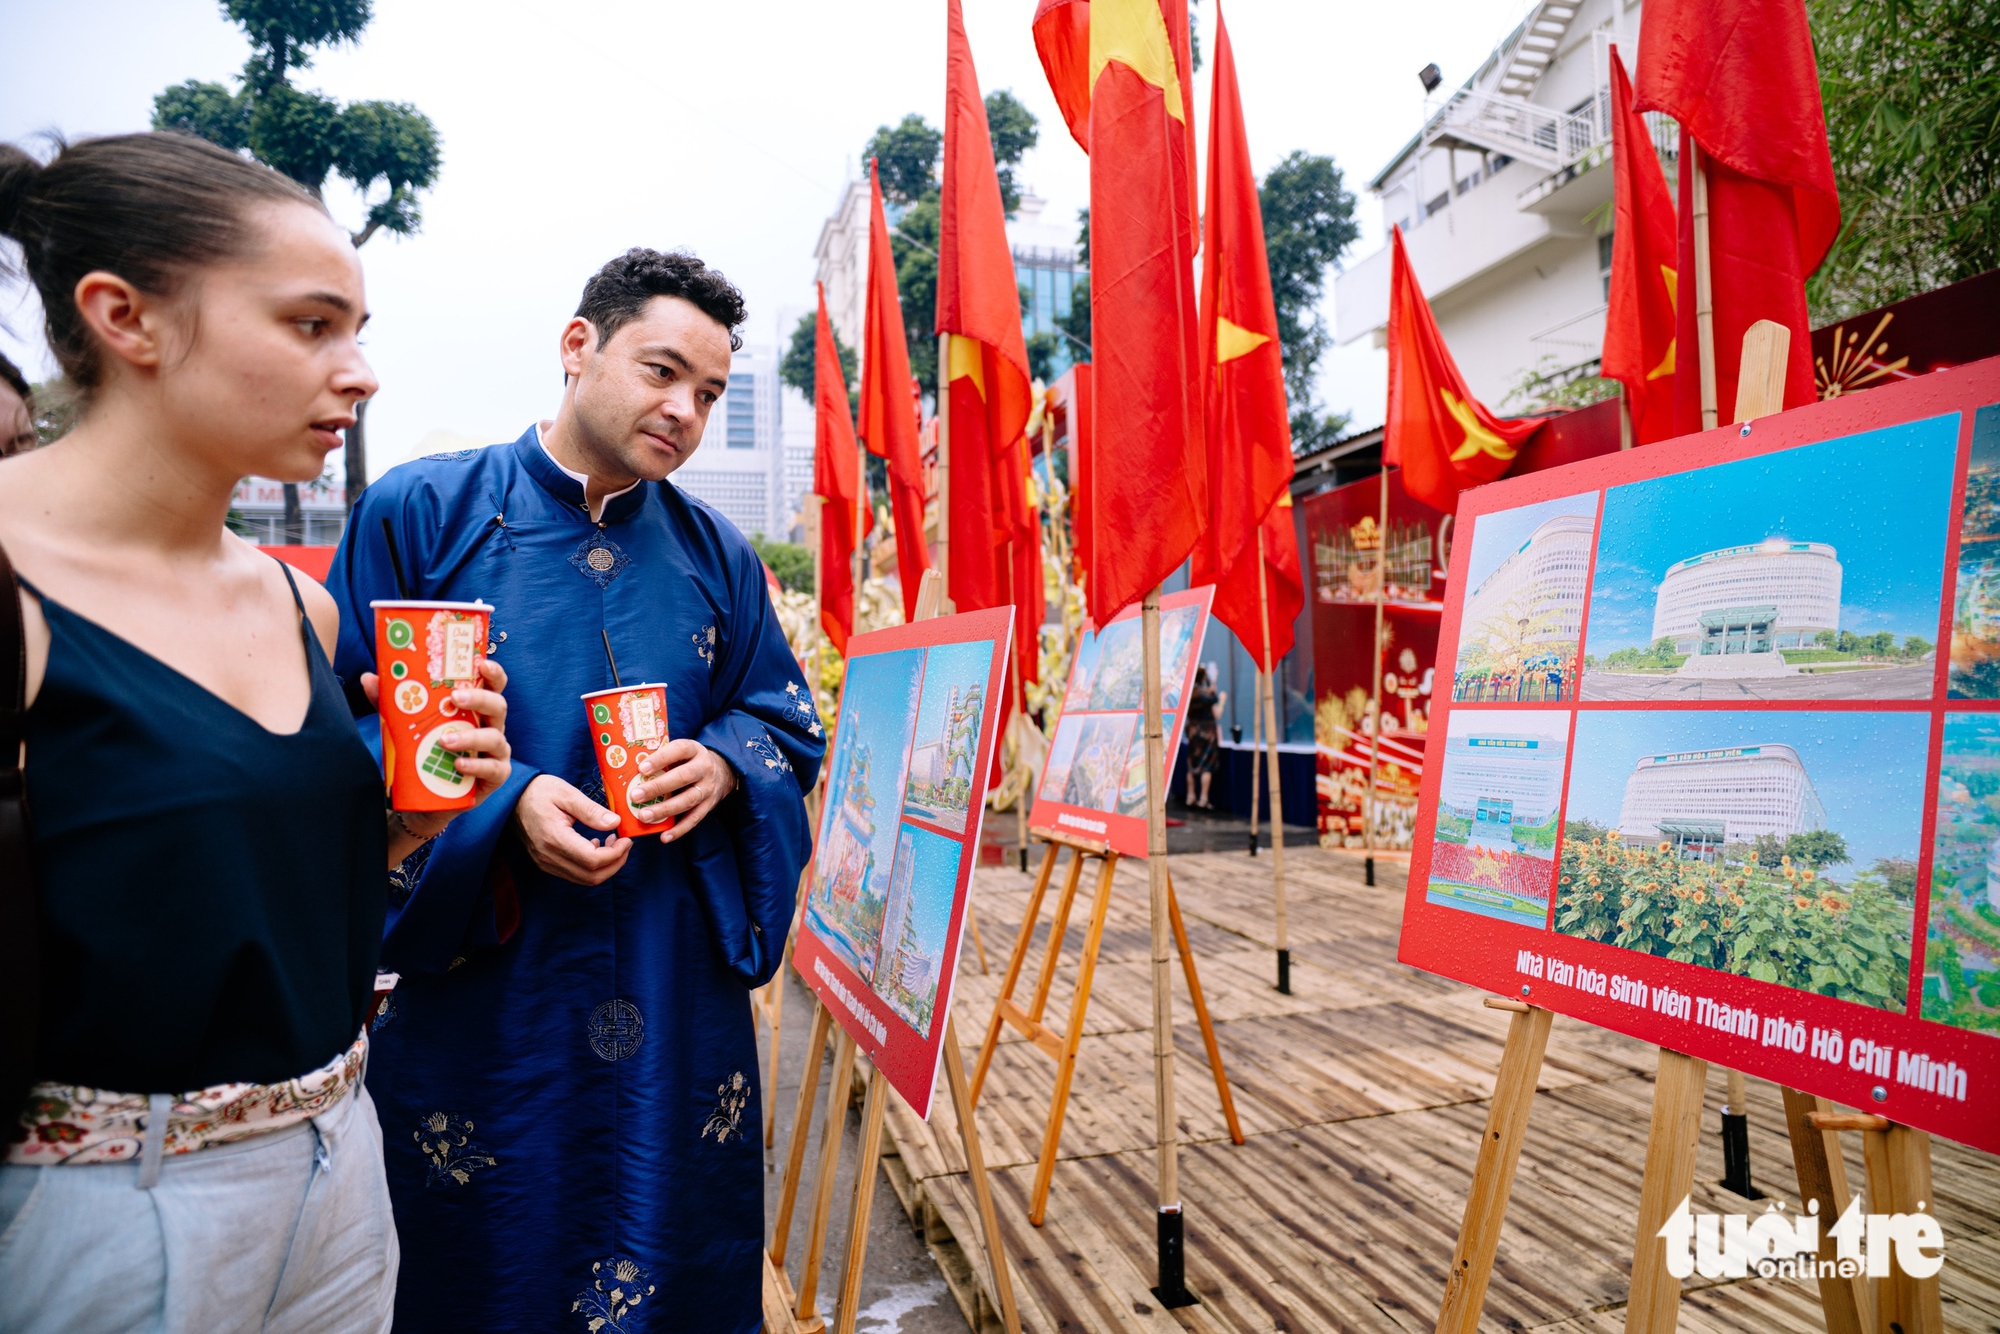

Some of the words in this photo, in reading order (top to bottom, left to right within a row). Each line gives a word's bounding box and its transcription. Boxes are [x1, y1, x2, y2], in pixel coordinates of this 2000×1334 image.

[1516, 949, 1544, 979] Nhà
[1546, 957, 1575, 987] Văn
[1575, 964, 1607, 997] hóa
[1609, 974, 1649, 1009] Sinh
[1652, 986, 1692, 1021] viên
[1696, 996, 1759, 1040] Thành
[1762, 1016, 1806, 1053] phố
[1810, 1027, 1844, 1065] Hồ
[1848, 1038, 1894, 1079] Chí
[1896, 1050, 1968, 1101] Minh
